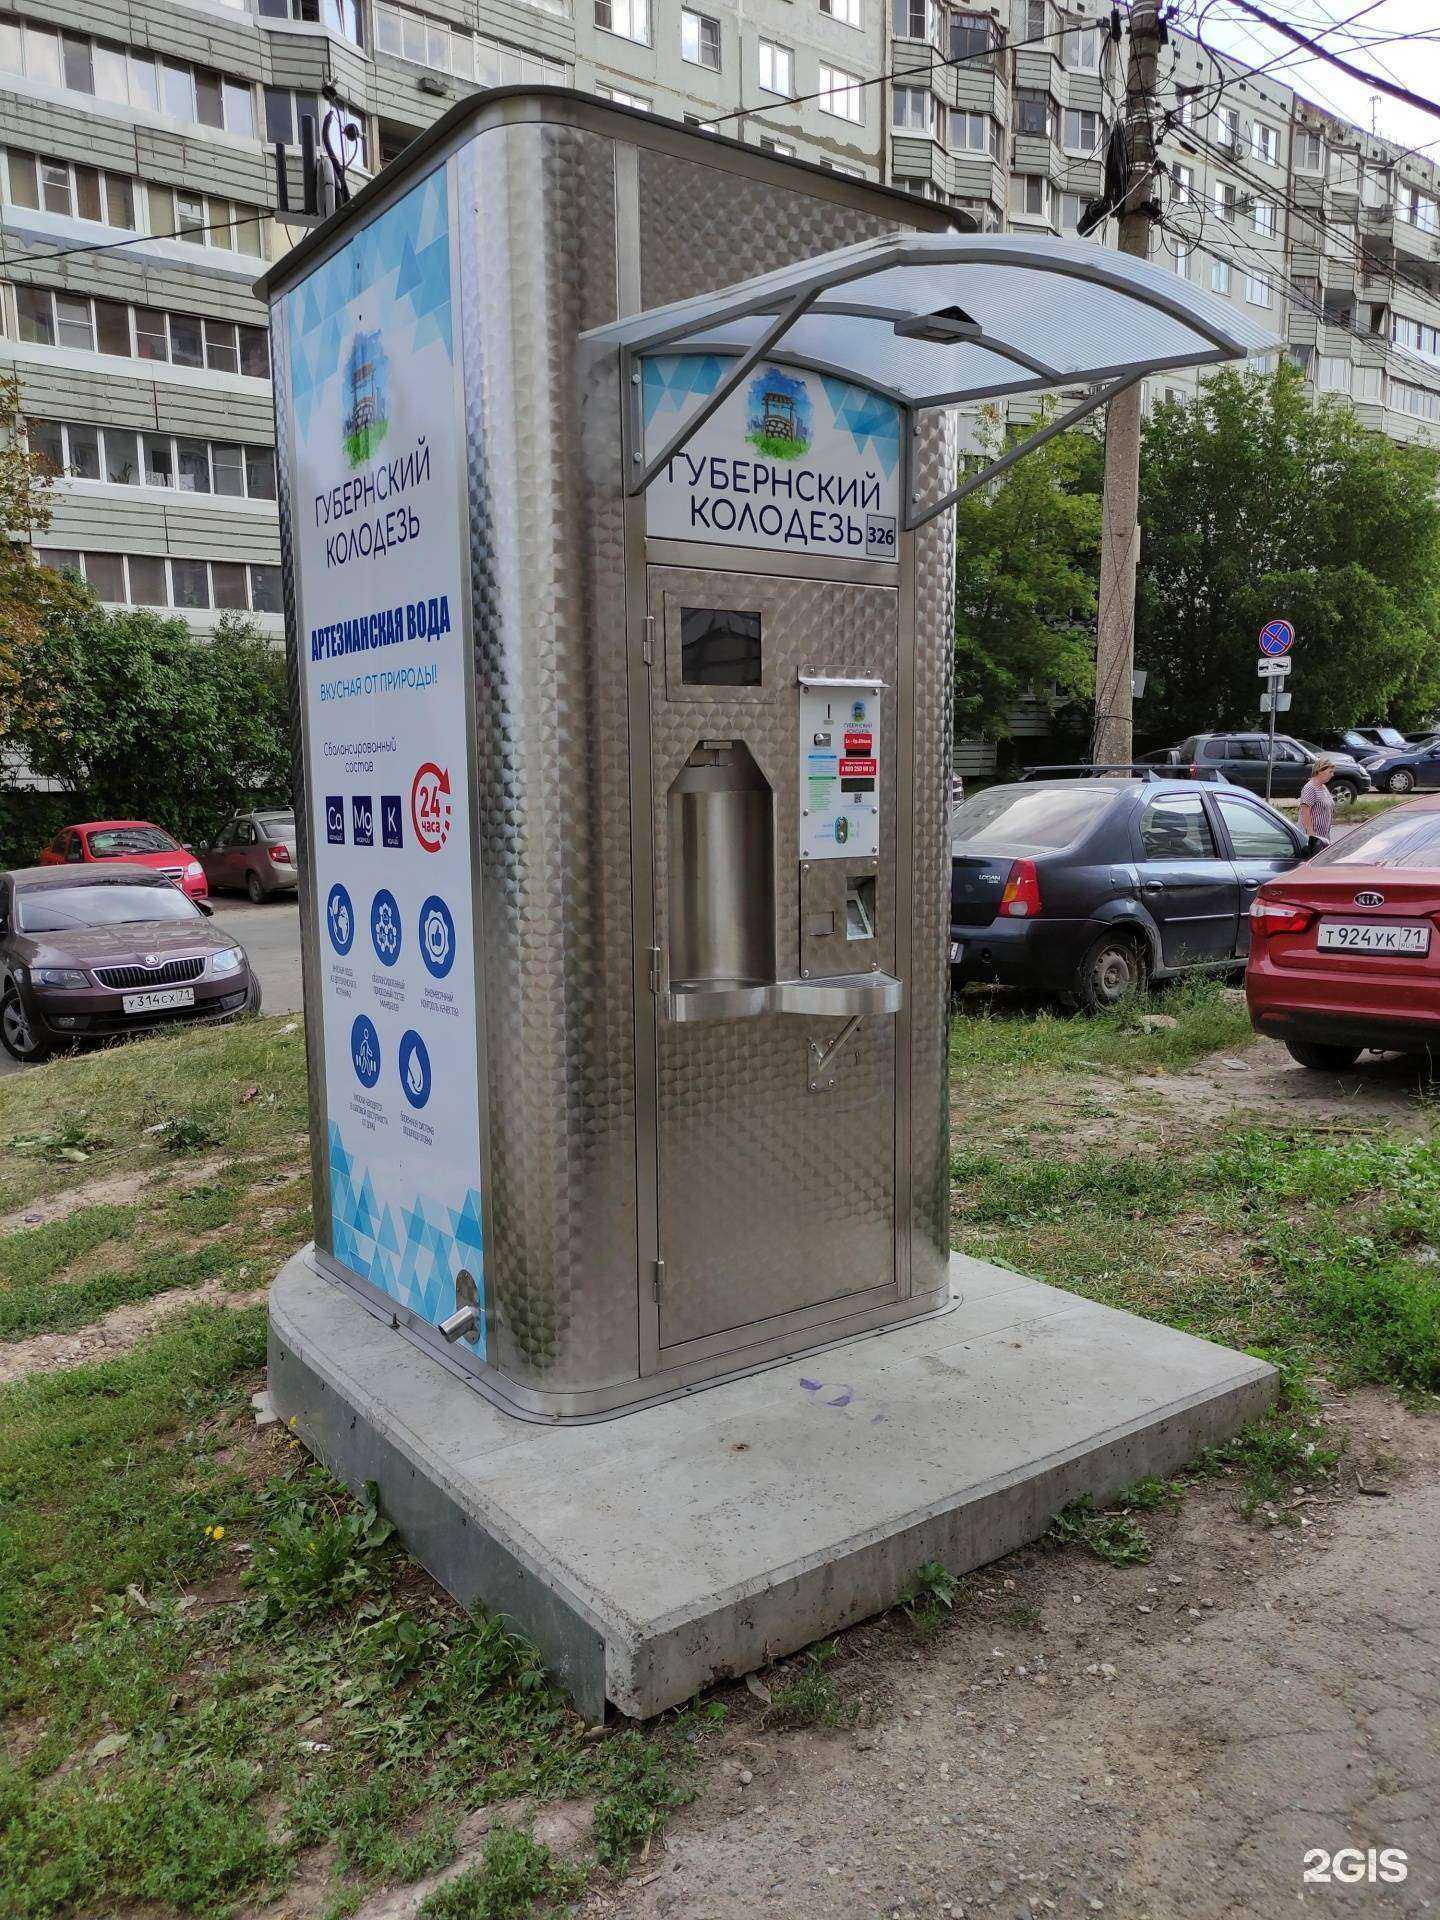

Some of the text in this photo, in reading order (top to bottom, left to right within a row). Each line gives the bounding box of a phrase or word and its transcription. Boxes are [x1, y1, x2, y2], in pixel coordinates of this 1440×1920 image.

[315, 435, 430, 527] ГУБЕРНСКИЙ
[668, 452, 880, 510] ГУБЕРНСКИЙ
[691, 495, 863, 545] КОЛОДЕЗЬ
[326, 505, 420, 568] КОЛОДЕЗЬ
[868, 527, 895, 545] 326
[311, 595, 450, 661] АРТЕЗИАНСКАЯ ВОДА
[320, 664, 438, 701] ВКУСНАЯ ОТ ПРИРОДЫ!
[345, 761, 374, 773] состав
[420, 786, 440, 818] 24
[328, 806, 343, 830] Ca
[354, 805, 372, 835] Mg
[388, 806, 397, 832] K
[422, 821, 440, 833] часа
[1357, 895, 1380, 905] KIA
[1403, 929, 1421, 943] 71
